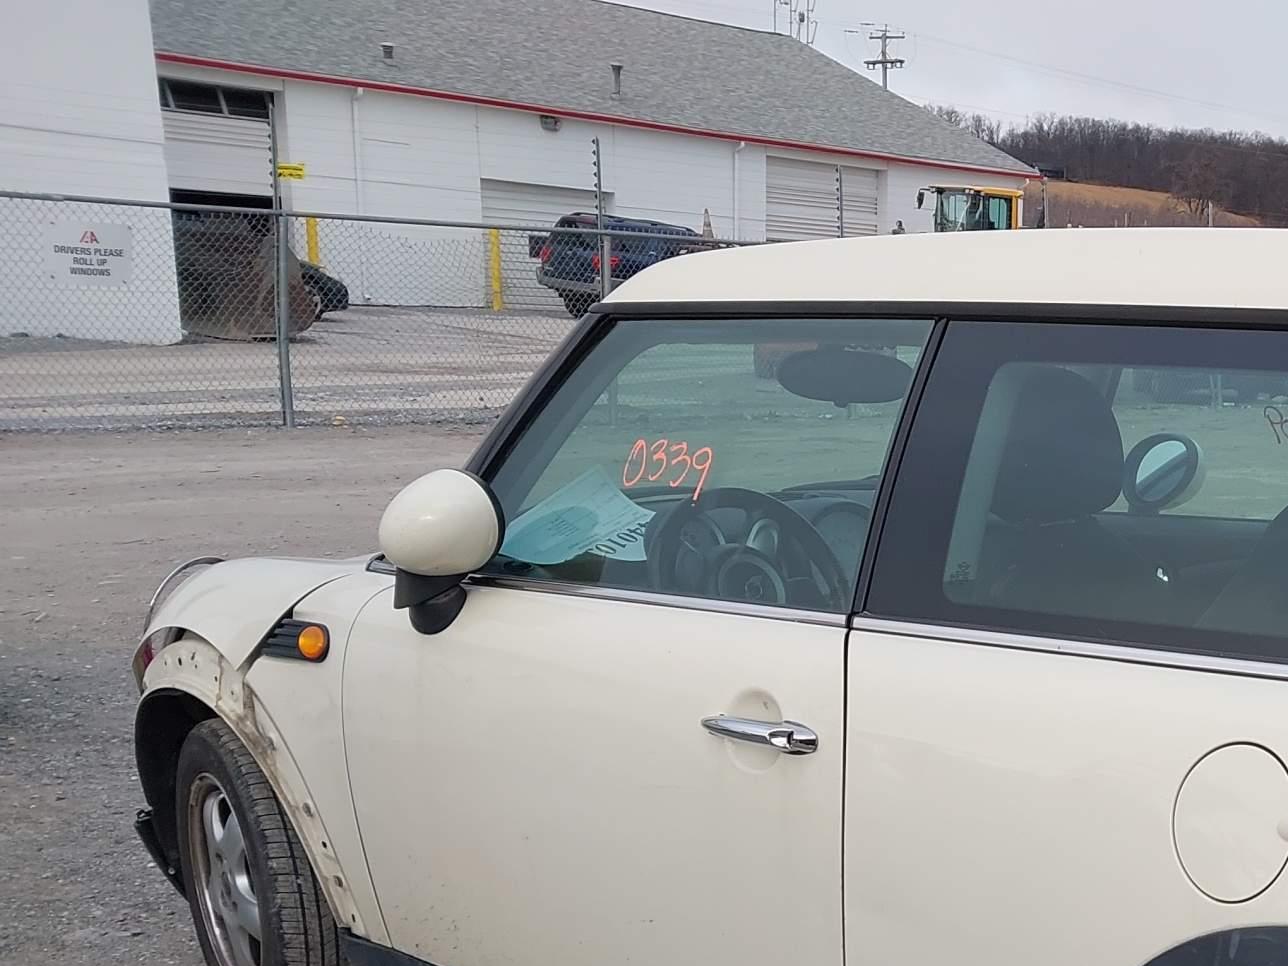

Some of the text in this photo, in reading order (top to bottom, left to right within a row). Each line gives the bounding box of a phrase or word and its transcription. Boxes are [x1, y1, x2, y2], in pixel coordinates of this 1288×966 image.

[53, 244, 123, 257] DRIVERS PLEASE
[73, 257, 94, 265] ROLL
[70, 267, 111, 276] WINDOWS
[623, 438, 712, 507] 0339
